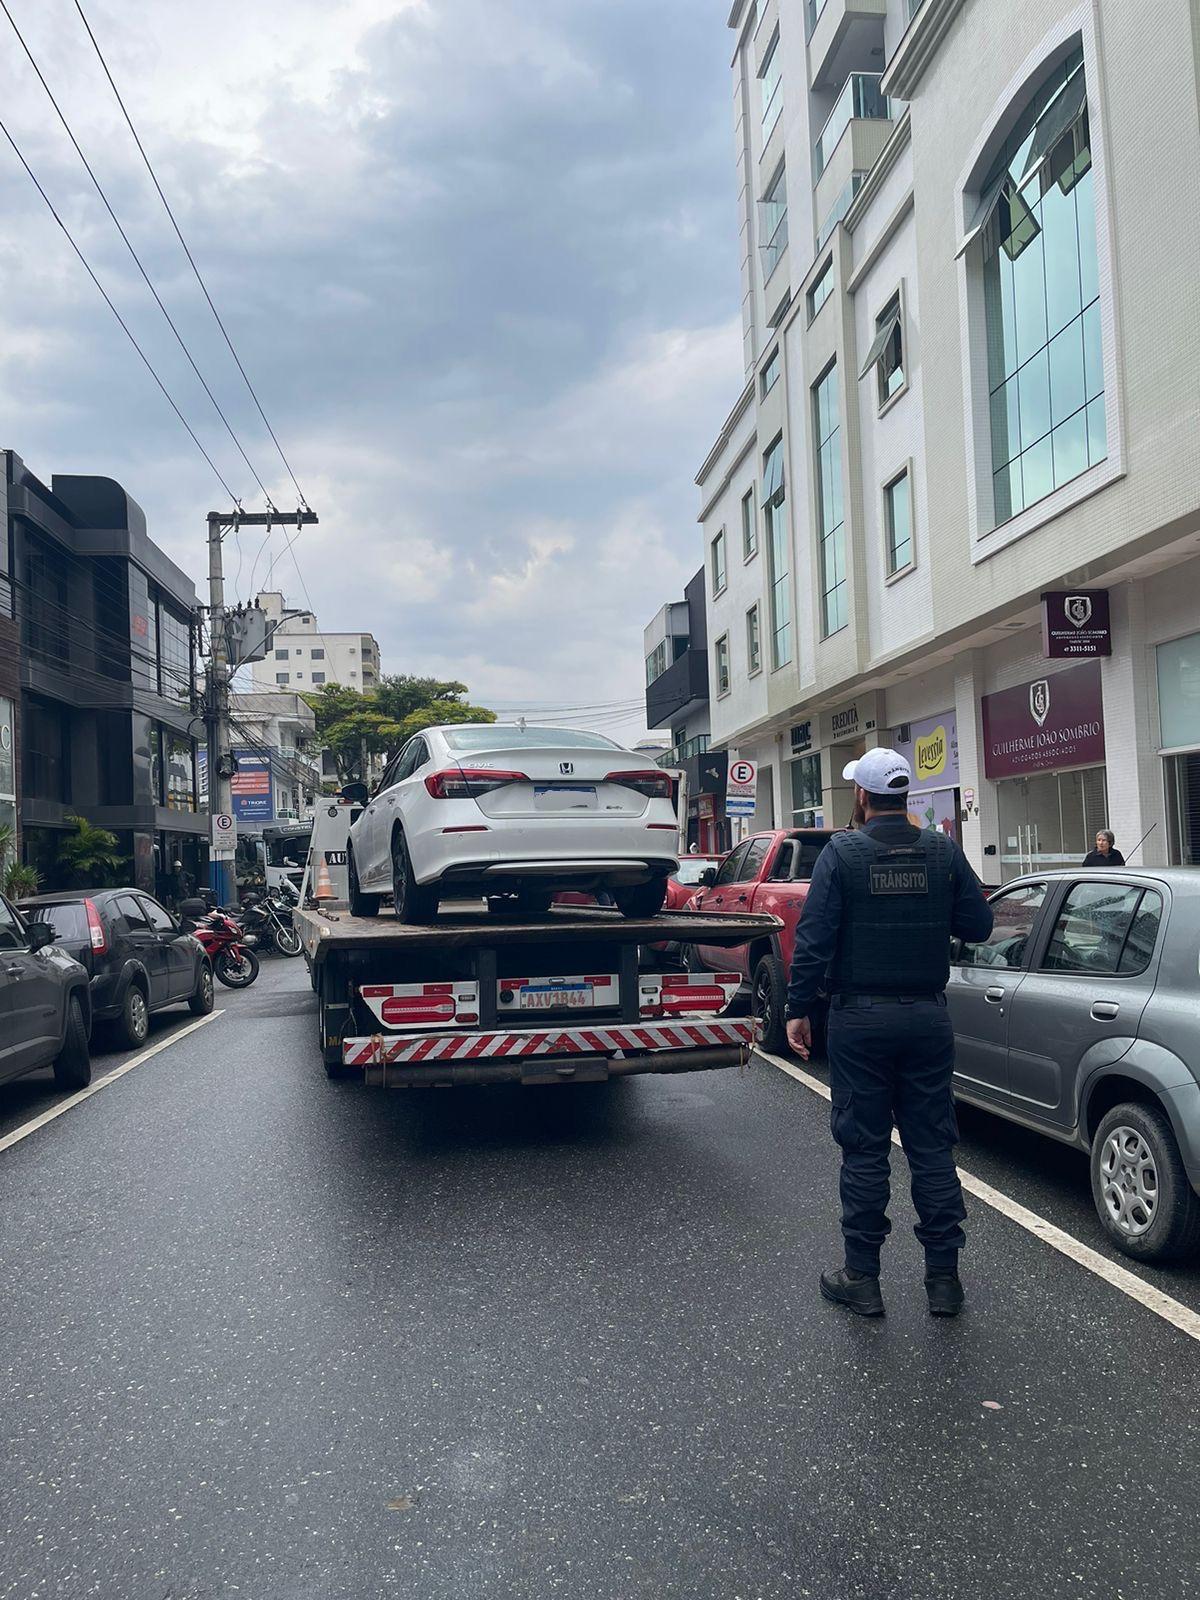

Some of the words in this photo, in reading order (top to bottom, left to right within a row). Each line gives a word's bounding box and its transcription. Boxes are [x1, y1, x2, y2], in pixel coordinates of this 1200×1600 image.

[1070, 645, 1097, 653] 3311-5151
[992, 735, 1035, 757] GUILHERME
[1036, 730, 1057, 749] JOÃO
[1058, 721, 1101, 743] SOMBRIO
[918, 736, 944, 769] Levessia
[738, 766, 747, 780] E
[222, 818, 228, 827] E
[873, 871, 926, 889] TRÂNSITO
